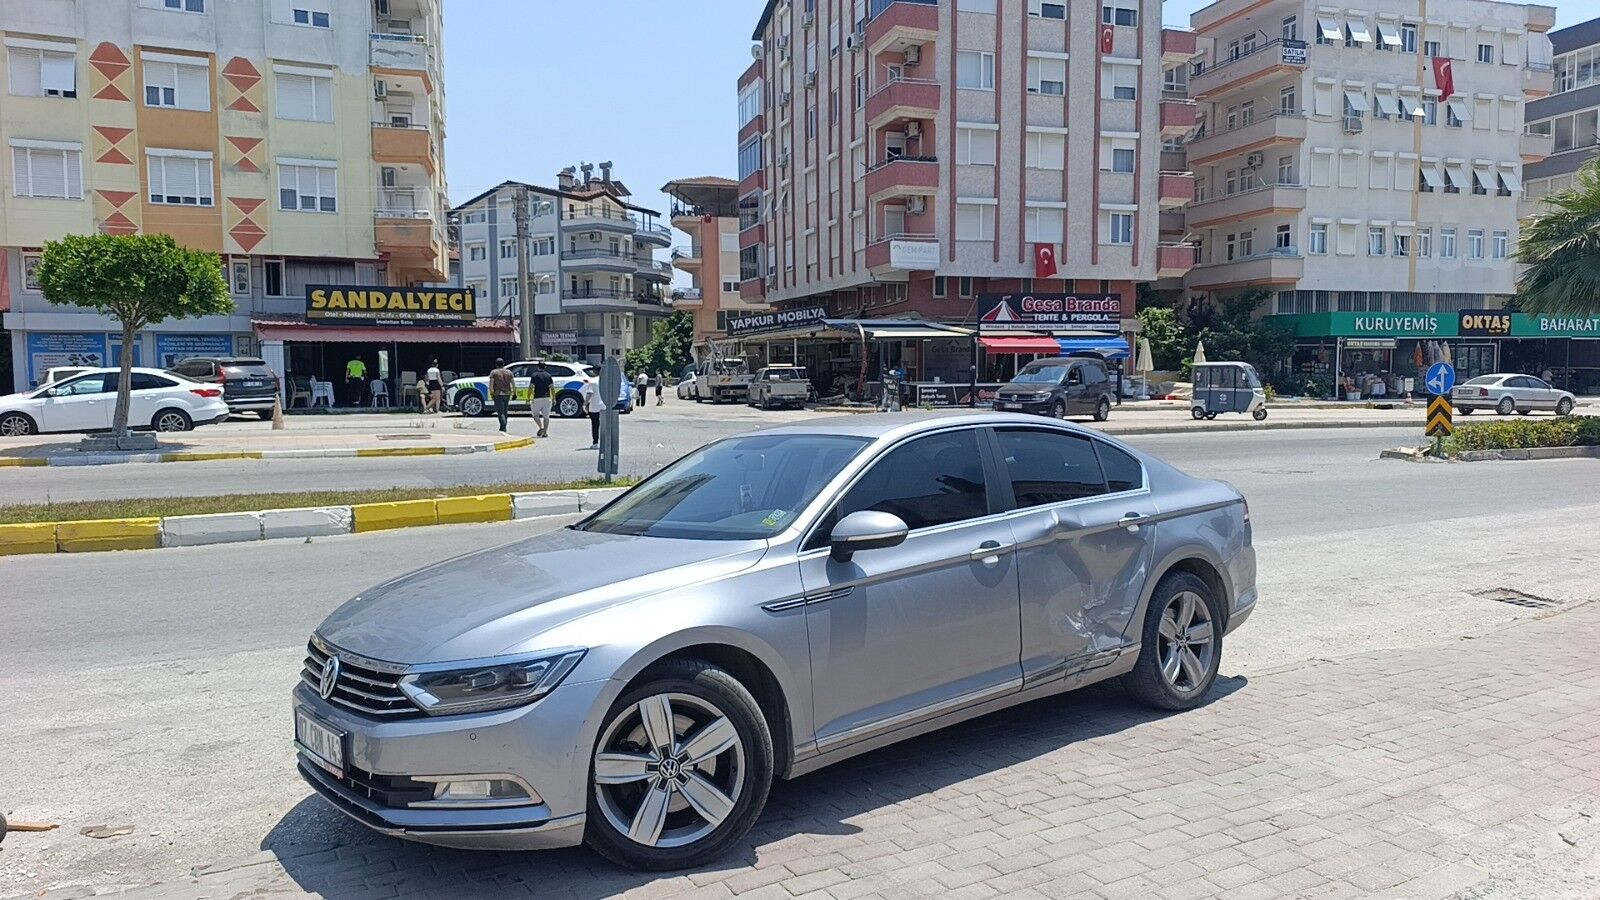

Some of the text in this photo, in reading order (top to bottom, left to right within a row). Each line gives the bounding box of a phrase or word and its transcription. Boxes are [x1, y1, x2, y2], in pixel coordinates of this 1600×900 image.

[311, 289, 473, 311] SANDALYECİ
[1021, 296, 1120, 312] Gesa Branda
[730, 315, 774, 330] YAPKUR
[777, 307, 826, 323] MOBİLYA
[1033, 313, 1109, 321] TENTE & PERGOLA
[1355, 314, 1438, 334] KURUYEMİŞ
[1462, 314, 1510, 333] OKTAŞ
[1540, 318, 1600, 331] BAHARAT
